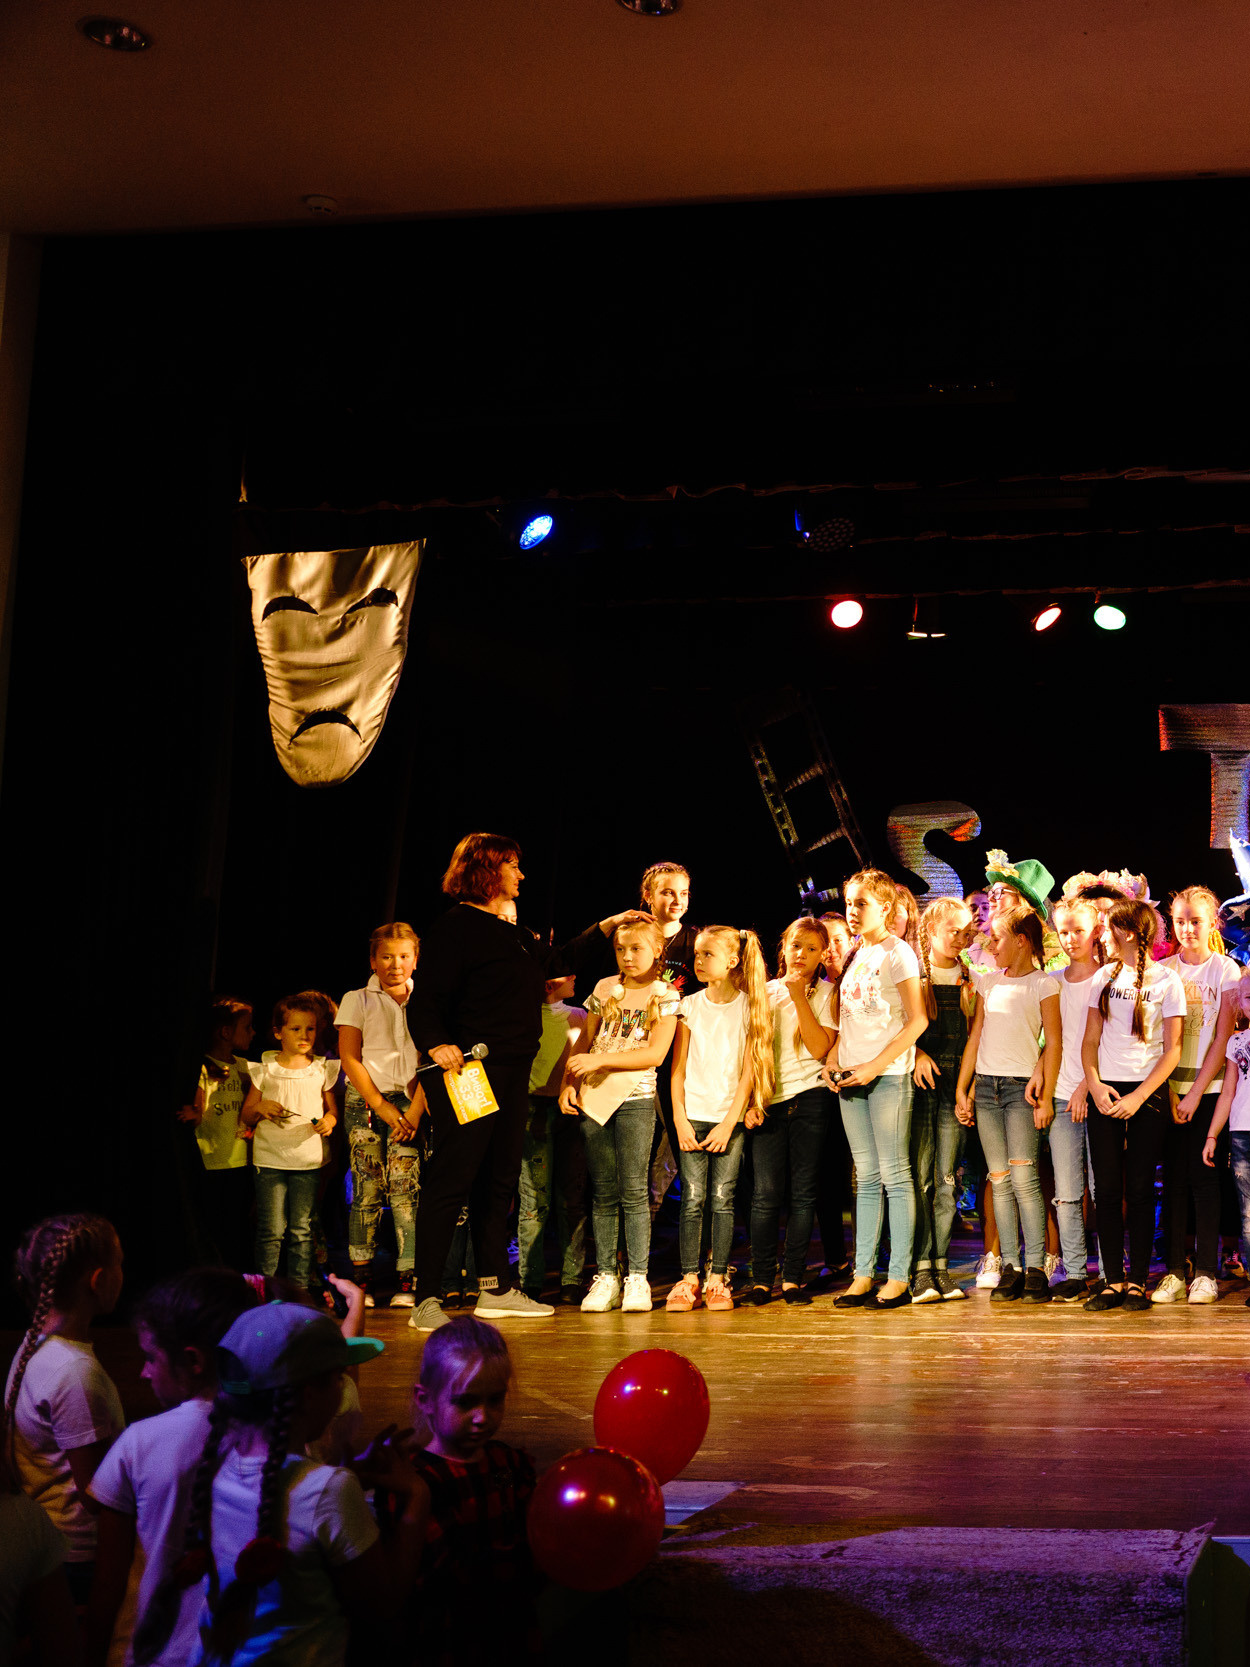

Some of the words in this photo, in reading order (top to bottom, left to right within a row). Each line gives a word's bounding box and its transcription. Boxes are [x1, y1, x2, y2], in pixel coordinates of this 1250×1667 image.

[1109, 987, 1151, 1003] OWERUL
[1184, 984, 1218, 1001] KLYN
[459, 1084, 474, 1101] 33
